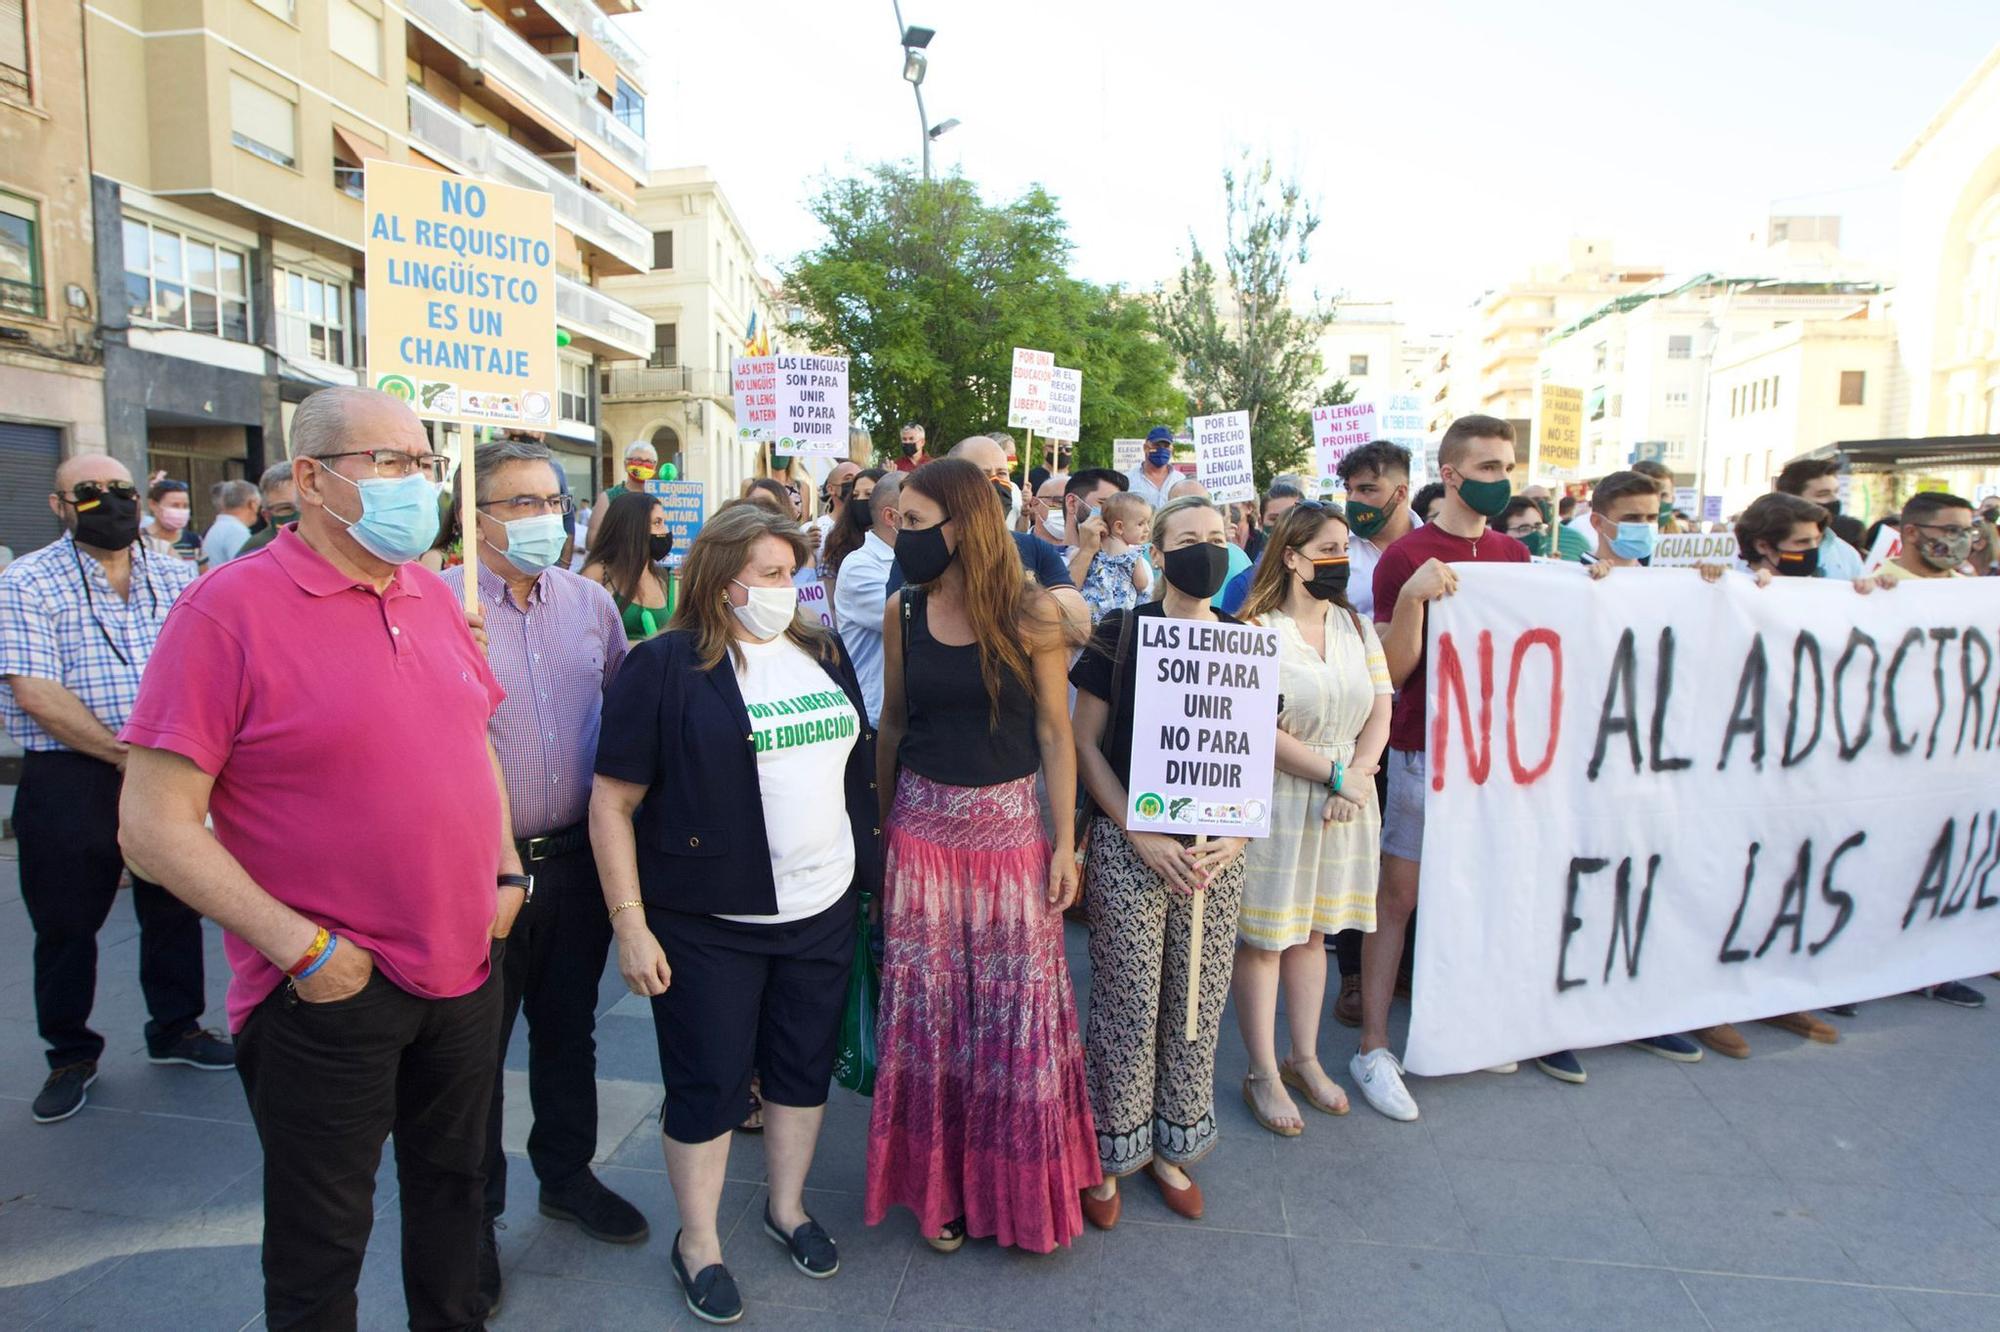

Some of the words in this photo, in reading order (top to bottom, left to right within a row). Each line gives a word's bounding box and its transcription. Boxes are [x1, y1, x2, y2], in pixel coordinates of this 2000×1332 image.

[441, 180, 486, 218] NO
[371, 213, 406, 243] AL
[415, 219, 550, 267] REQUISITO
[388, 258, 538, 305] LINGÜÍSTCO
[427, 301, 458, 331] ES
[469, 307, 502, 337] UN
[400, 336, 529, 377] CHANTAJE
[1019, 351, 1034, 364] POR
[738, 363, 751, 375] LAS
[777, 358, 797, 370] LAS
[800, 358, 846, 373] LENGUAS
[786, 374, 807, 386] SON
[811, 375, 838, 388] PARA
[1064, 370, 1073, 380] EL
[735, 379, 745, 391] NO
[1028, 384, 1038, 395] EN
[745, 394, 755, 406] EN
[800, 390, 825, 402] UNIR
[789, 405, 805, 418] NO
[808, 406, 835, 419] PARA
[1014, 398, 1047, 411] LIBERTAD
[1314, 410, 1328, 421] LA
[1331, 403, 1375, 419] LENGUA
[793, 422, 832, 435] DIVIDIR
[1204, 417, 1225, 430] POR
[1227, 416, 1239, 427] EL
[1330, 422, 1342, 433] NI
[1346, 420, 1360, 431] SE
[1201, 429, 1245, 445] DERECHO
[1322, 432, 1371, 447] PROHIBE
[1547, 428, 1561, 440] NO
[1563, 430, 1576, 442] SE
[1202, 449, 1210, 460] A
[1212, 444, 1245, 458] ELEGIR
[1333, 448, 1344, 460] NI
[1206, 459, 1243, 475] LENGUA
[660, 483, 703, 495] REQUISITO
[672, 524, 688, 535] LOS
[1142, 623, 1181, 649] LAS
[1188, 627, 1278, 657] LENGUAS
[1157, 657, 1200, 685] SON
[1207, 661, 1260, 689] PARA
[746, 703, 774, 719] OR
[769, 700, 795, 716] LA
[1184, 693, 1233, 720] UNIR
[1431, 627, 1565, 793] NO
[1587, 625, 1692, 781] AL
[753, 729, 773, 753] DE
[1160, 725, 1190, 751] NO
[1197, 727, 1251, 755] PARA
[1165, 759, 1242, 788] DIVIDIR
[1555, 853, 1661, 994] EN
[1719, 831, 1867, 964] LAS
